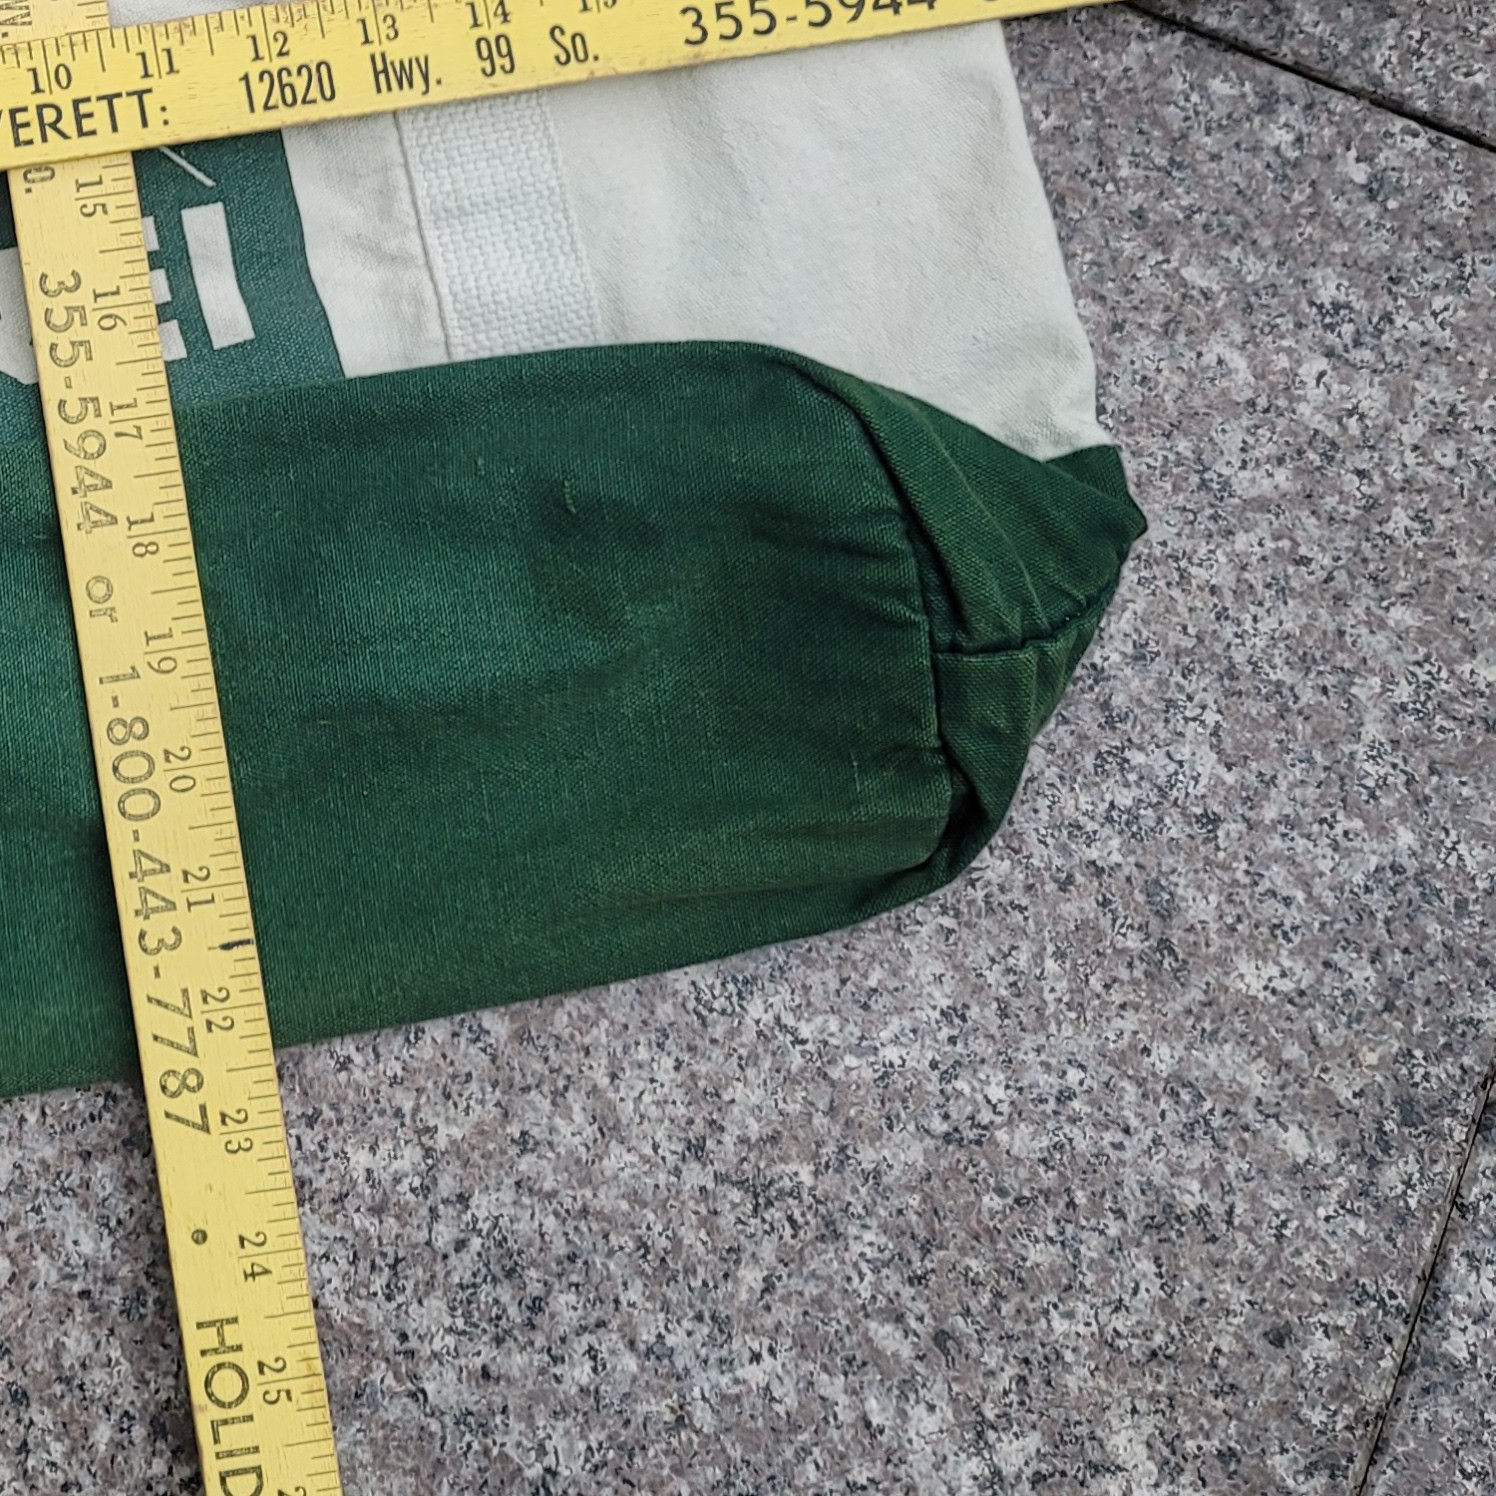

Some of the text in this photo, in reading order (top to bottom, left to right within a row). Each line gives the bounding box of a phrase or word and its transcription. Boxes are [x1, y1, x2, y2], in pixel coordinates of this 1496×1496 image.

[26, 62, 72, 95] 10
[135, 46, 179, 79] 11
[246, 29, 290, 62] 12
[356, 13, 399, 45] 13
[239, 60, 336, 113] 12620
[369, 51, 441, 95] Hwy.
[474, 33, 515, 77] 99
[548, 24, 599, 66] So.
[74, 174, 108, 218] 15
[91, 285, 126, 331] 16
[38, 271, 117, 533] 355-5944
[108, 397, 143, 440] 17
[125, 511, 159, 558] 18
[84, 574, 118, 623] or
[143, 626, 178, 675] 19
[162, 745, 196, 793] 20
[100, 665, 209, 1132] 1-800-443-7787
[181, 865, 215, 912] 21
[199, 986, 235, 1033] 22
[218, 1107, 253, 1154] 23
[237, 1230, 272, 1282] 24
[256, 1356, 292, 1405] 25
